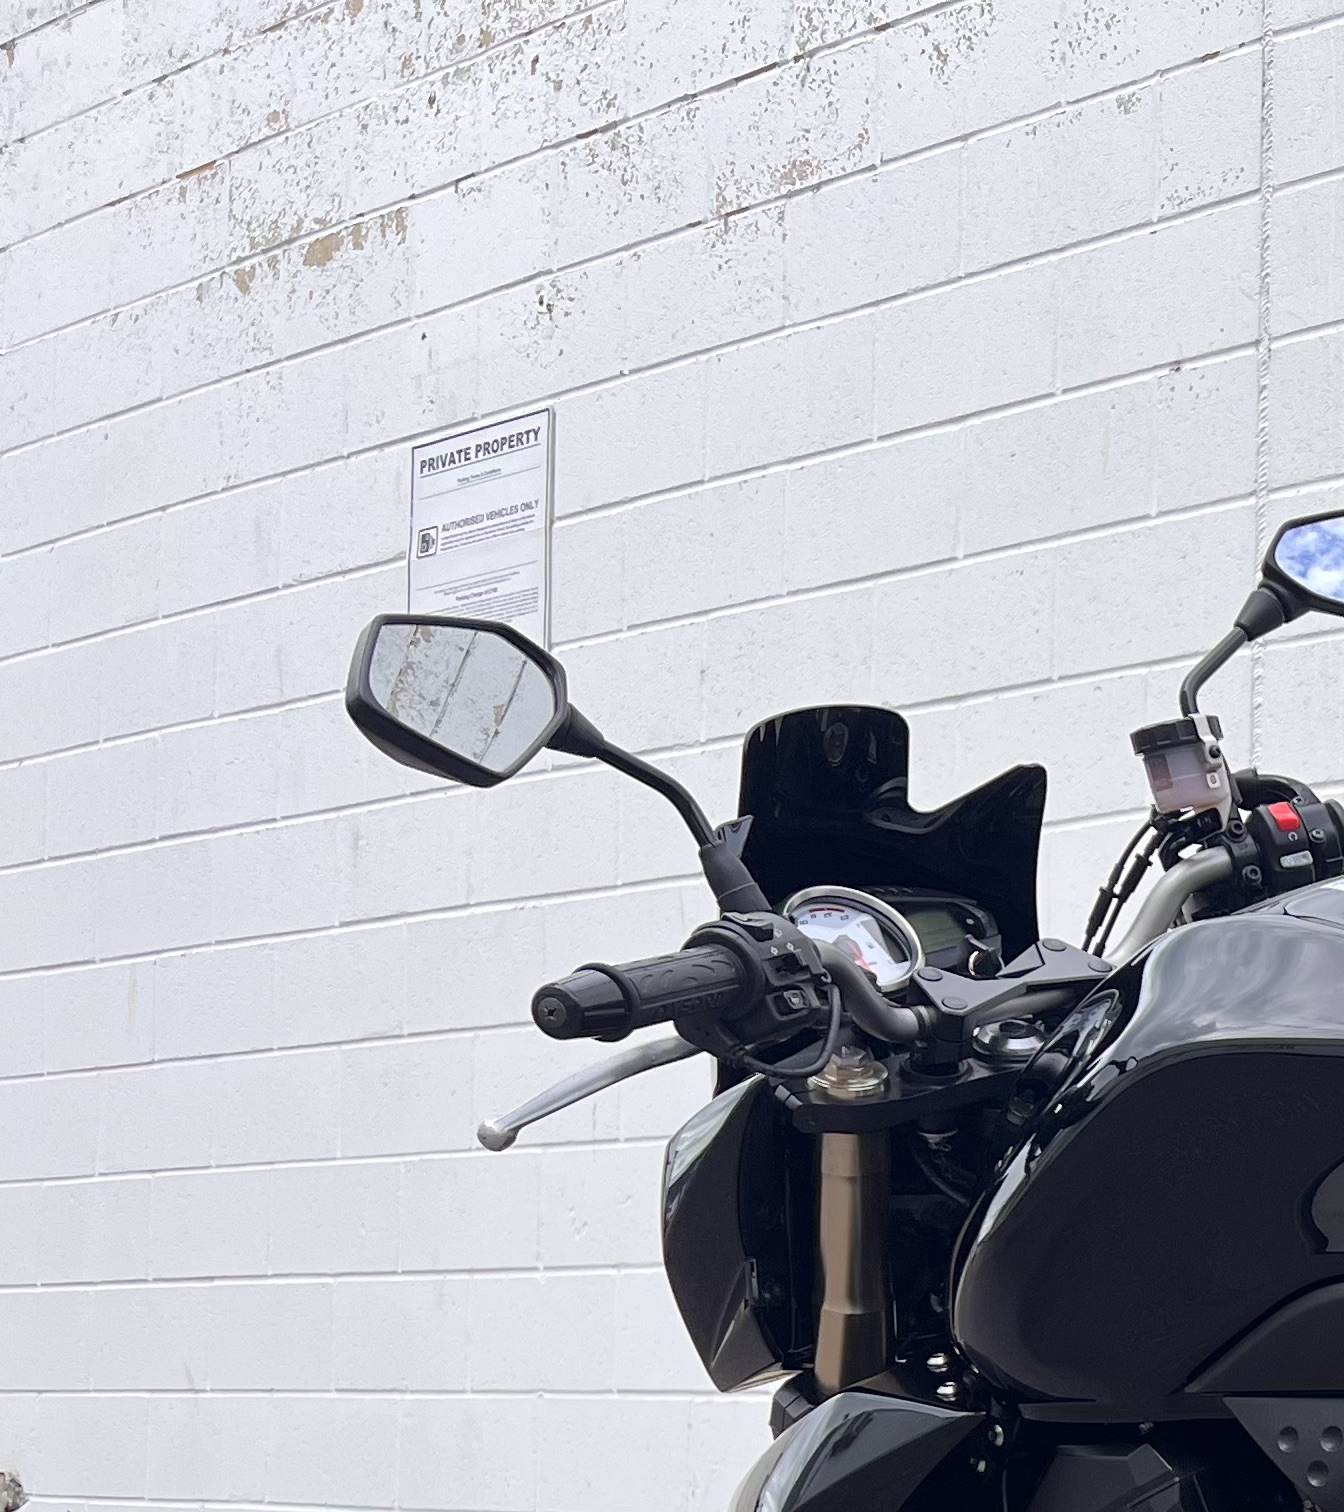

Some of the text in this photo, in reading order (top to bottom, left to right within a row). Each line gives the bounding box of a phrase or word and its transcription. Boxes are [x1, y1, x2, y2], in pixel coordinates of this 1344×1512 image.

[420, 426, 541, 474] PRIVATE PROPERTY
[441, 498, 540, 532] AUTHORISED VEHICLES ONLY
